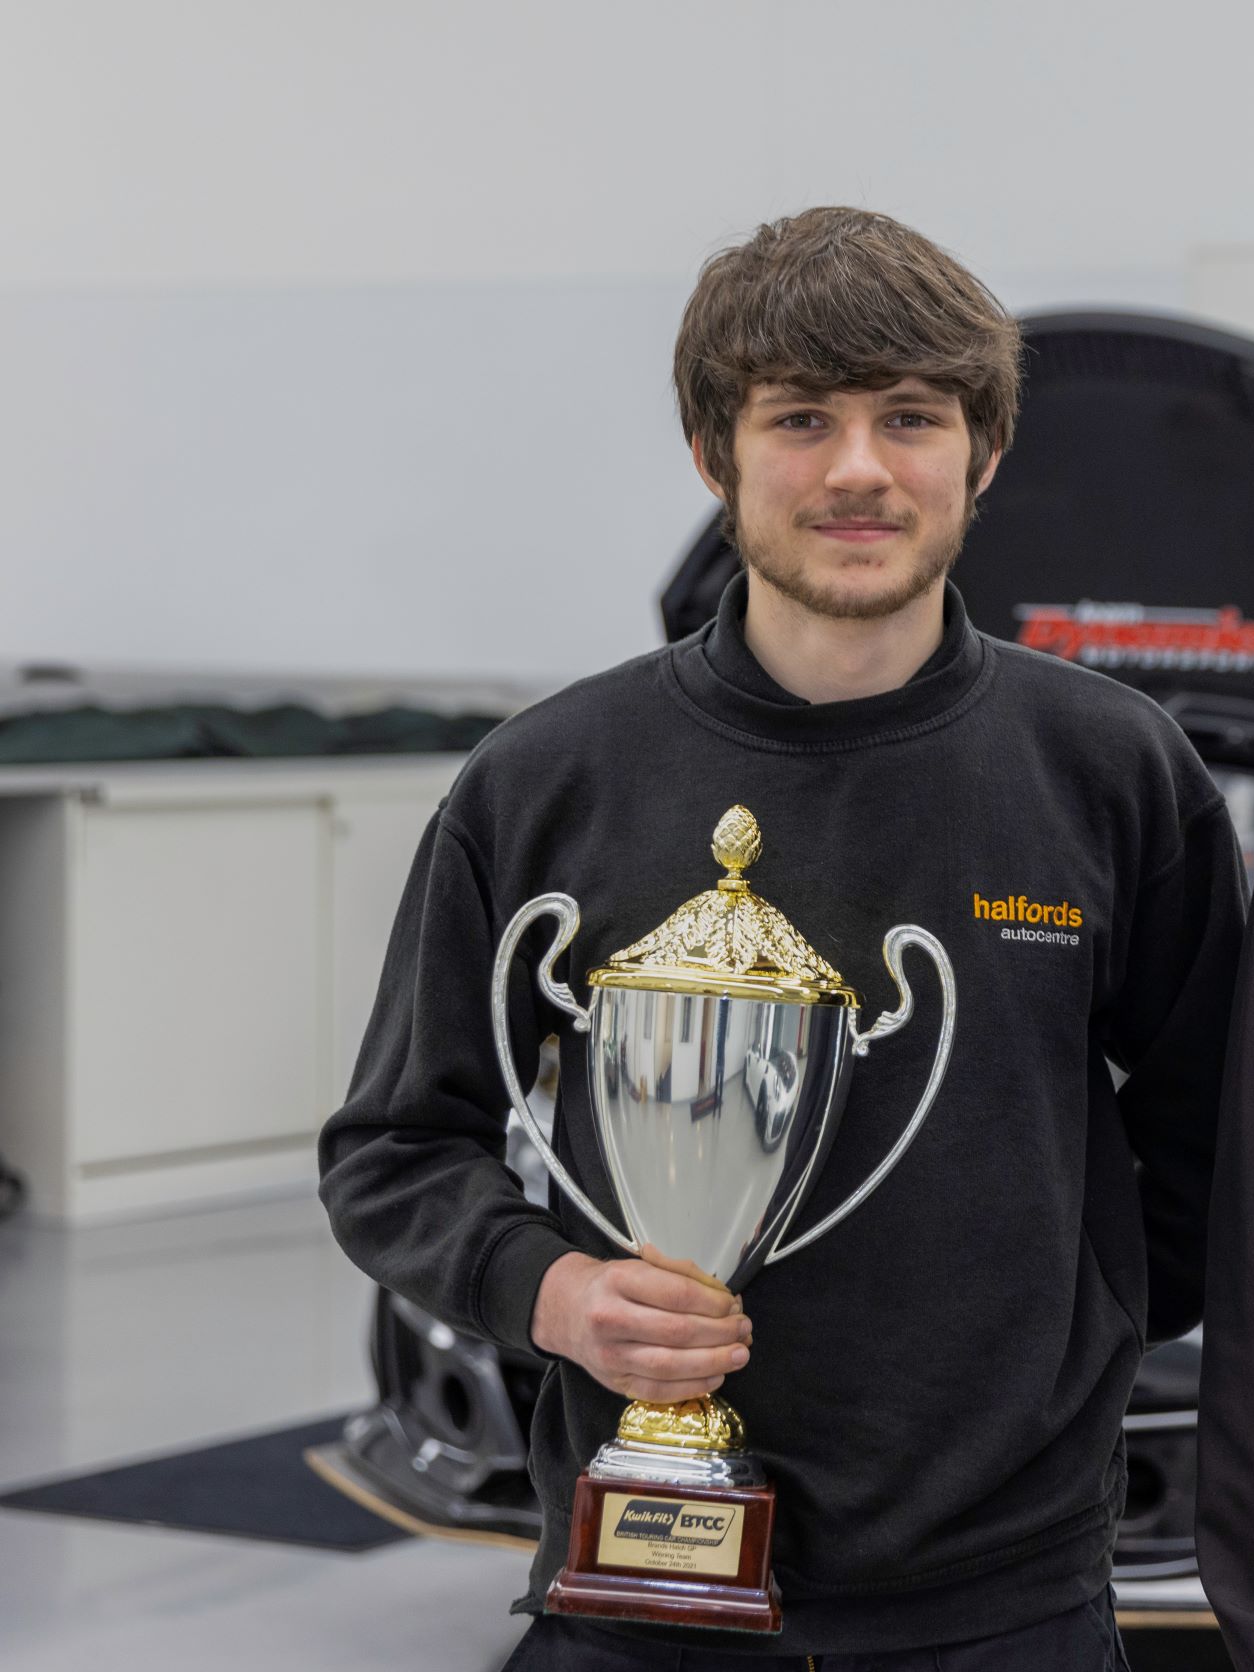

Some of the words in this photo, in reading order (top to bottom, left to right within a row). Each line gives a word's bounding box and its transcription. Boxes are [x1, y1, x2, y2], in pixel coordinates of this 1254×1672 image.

[973, 893, 1083, 927] halfords
[1001, 927, 1080, 946] autocentre
[680, 1513, 725, 1531] BTCC
[616, 1531, 638, 1539] BRITISH
[639, 1533, 664, 1541] TOURING
[677, 1536, 719, 1545] CHAMPIONSHIP
[669, 1543, 685, 1551] Hatch
[644, 1559, 668, 1567] October
[676, 1552, 692, 1560] Team
